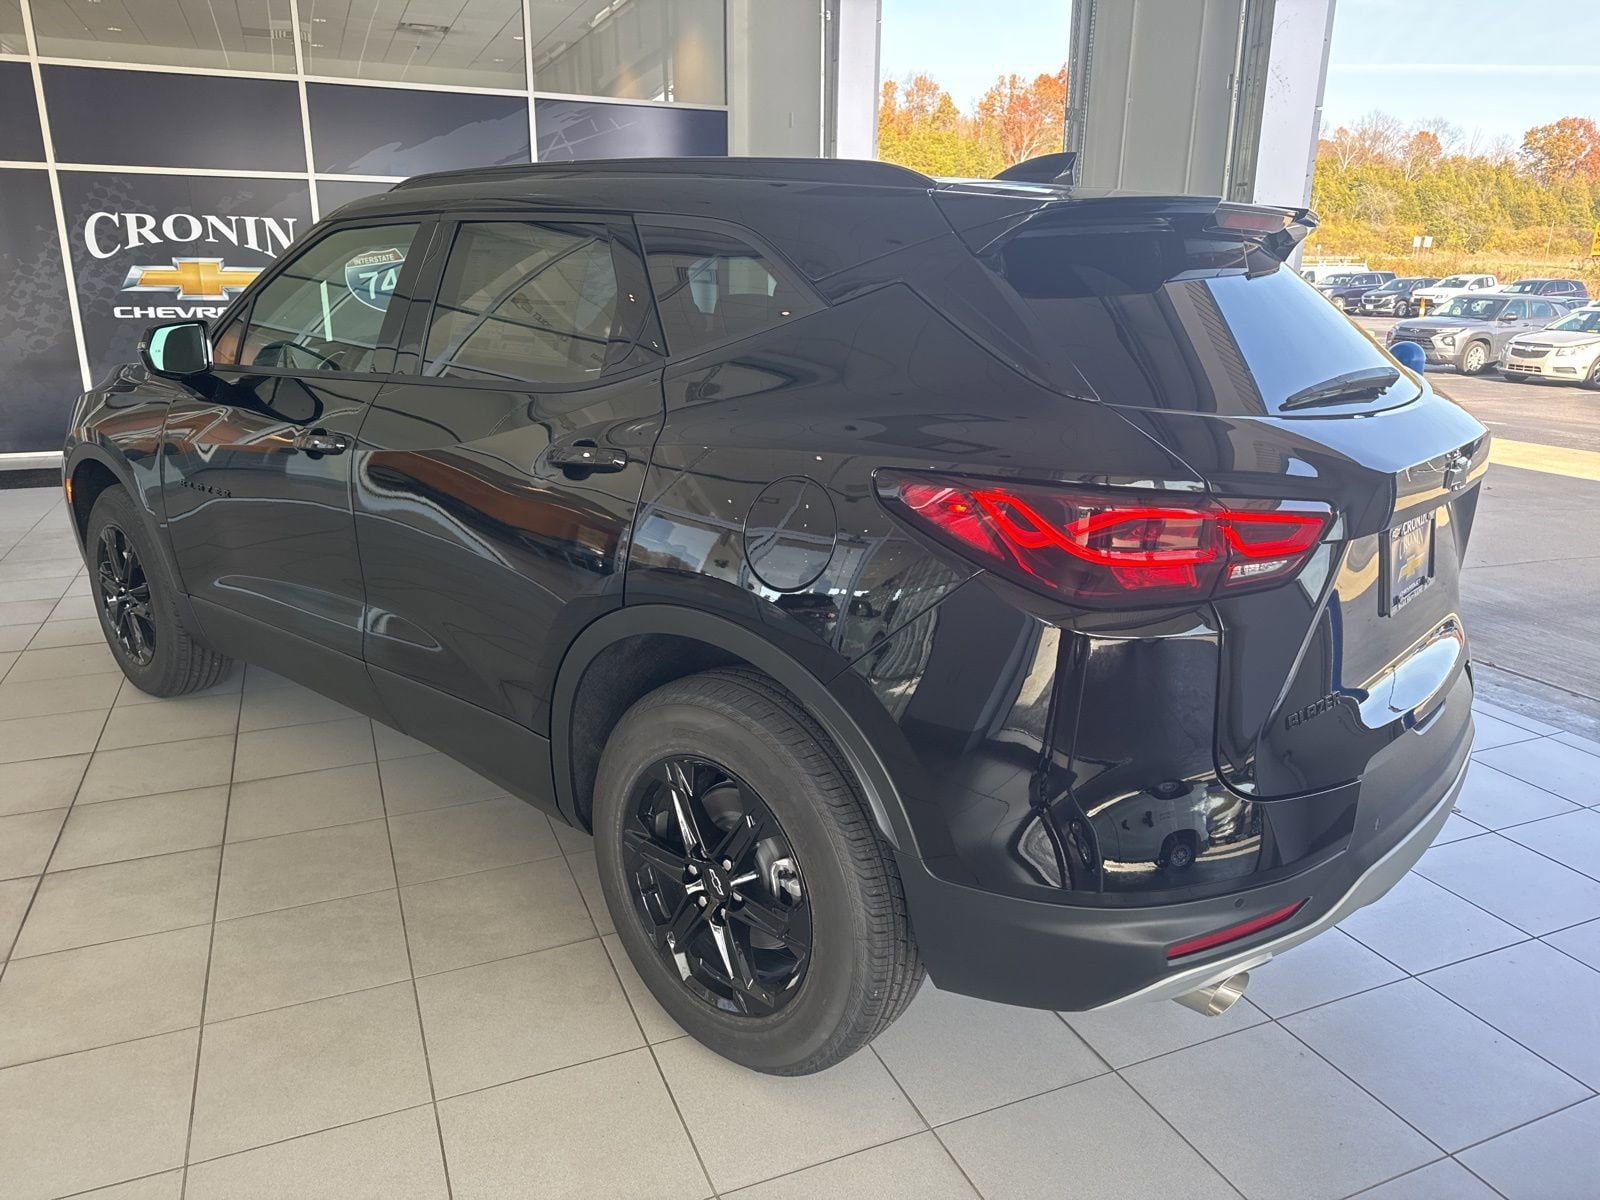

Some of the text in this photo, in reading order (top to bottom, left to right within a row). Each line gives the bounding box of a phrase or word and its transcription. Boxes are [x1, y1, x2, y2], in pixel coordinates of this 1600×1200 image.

[84, 211, 297, 259] CRONIN
[359, 268, 397, 300] 74
[1286, 690, 1341, 729] BLAZER
